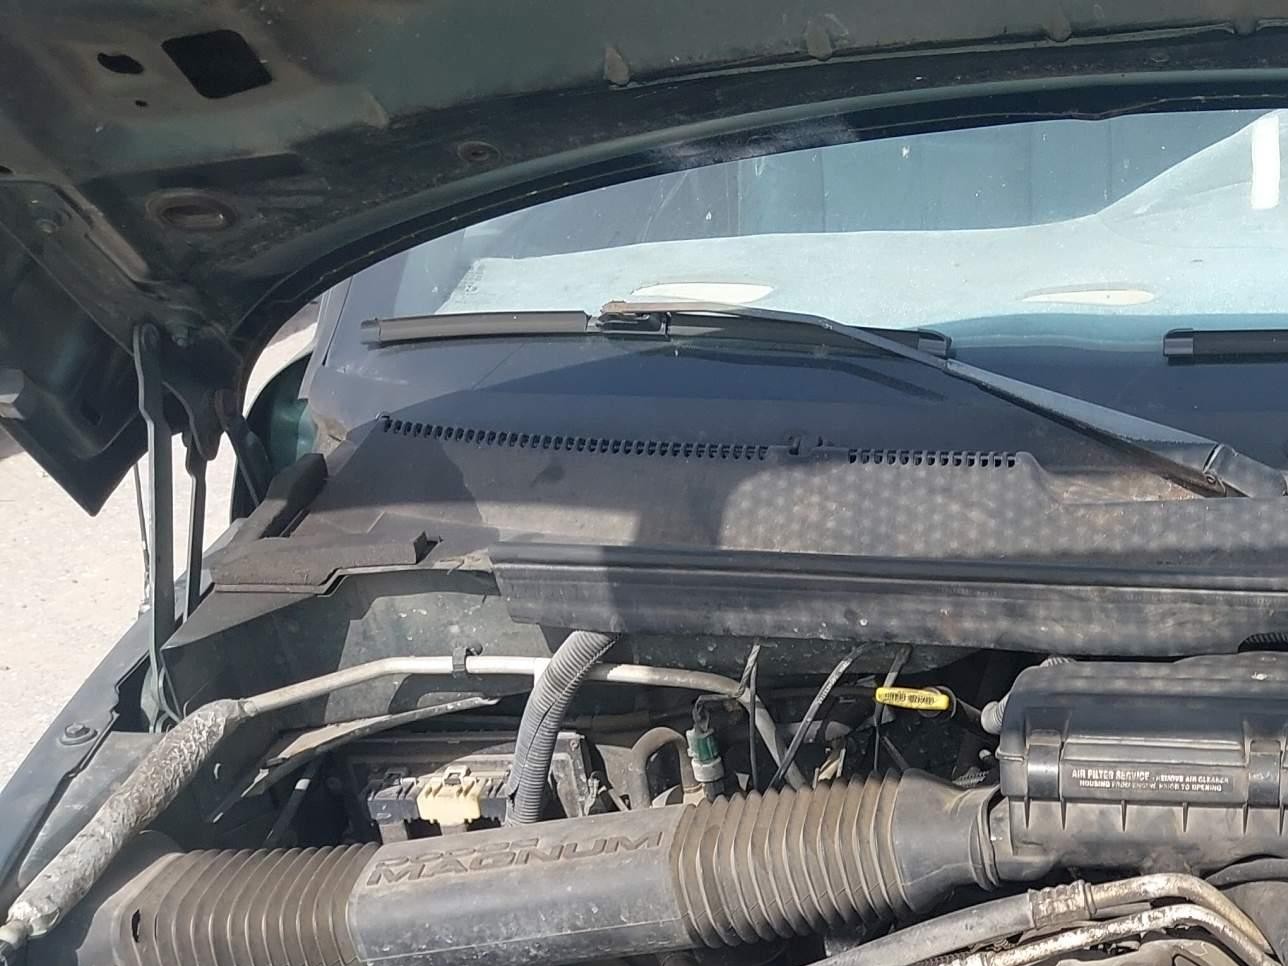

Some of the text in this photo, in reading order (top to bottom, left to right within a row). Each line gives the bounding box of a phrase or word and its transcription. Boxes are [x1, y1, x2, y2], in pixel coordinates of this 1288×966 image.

[1072, 768, 1085, 779] AIR
[1087, 769, 1114, 780] FILTER
[1116, 769, 1150, 781] SERVICE
[1185, 775, 1197, 784] AIR
[366, 831, 663, 886] MAGNUM
